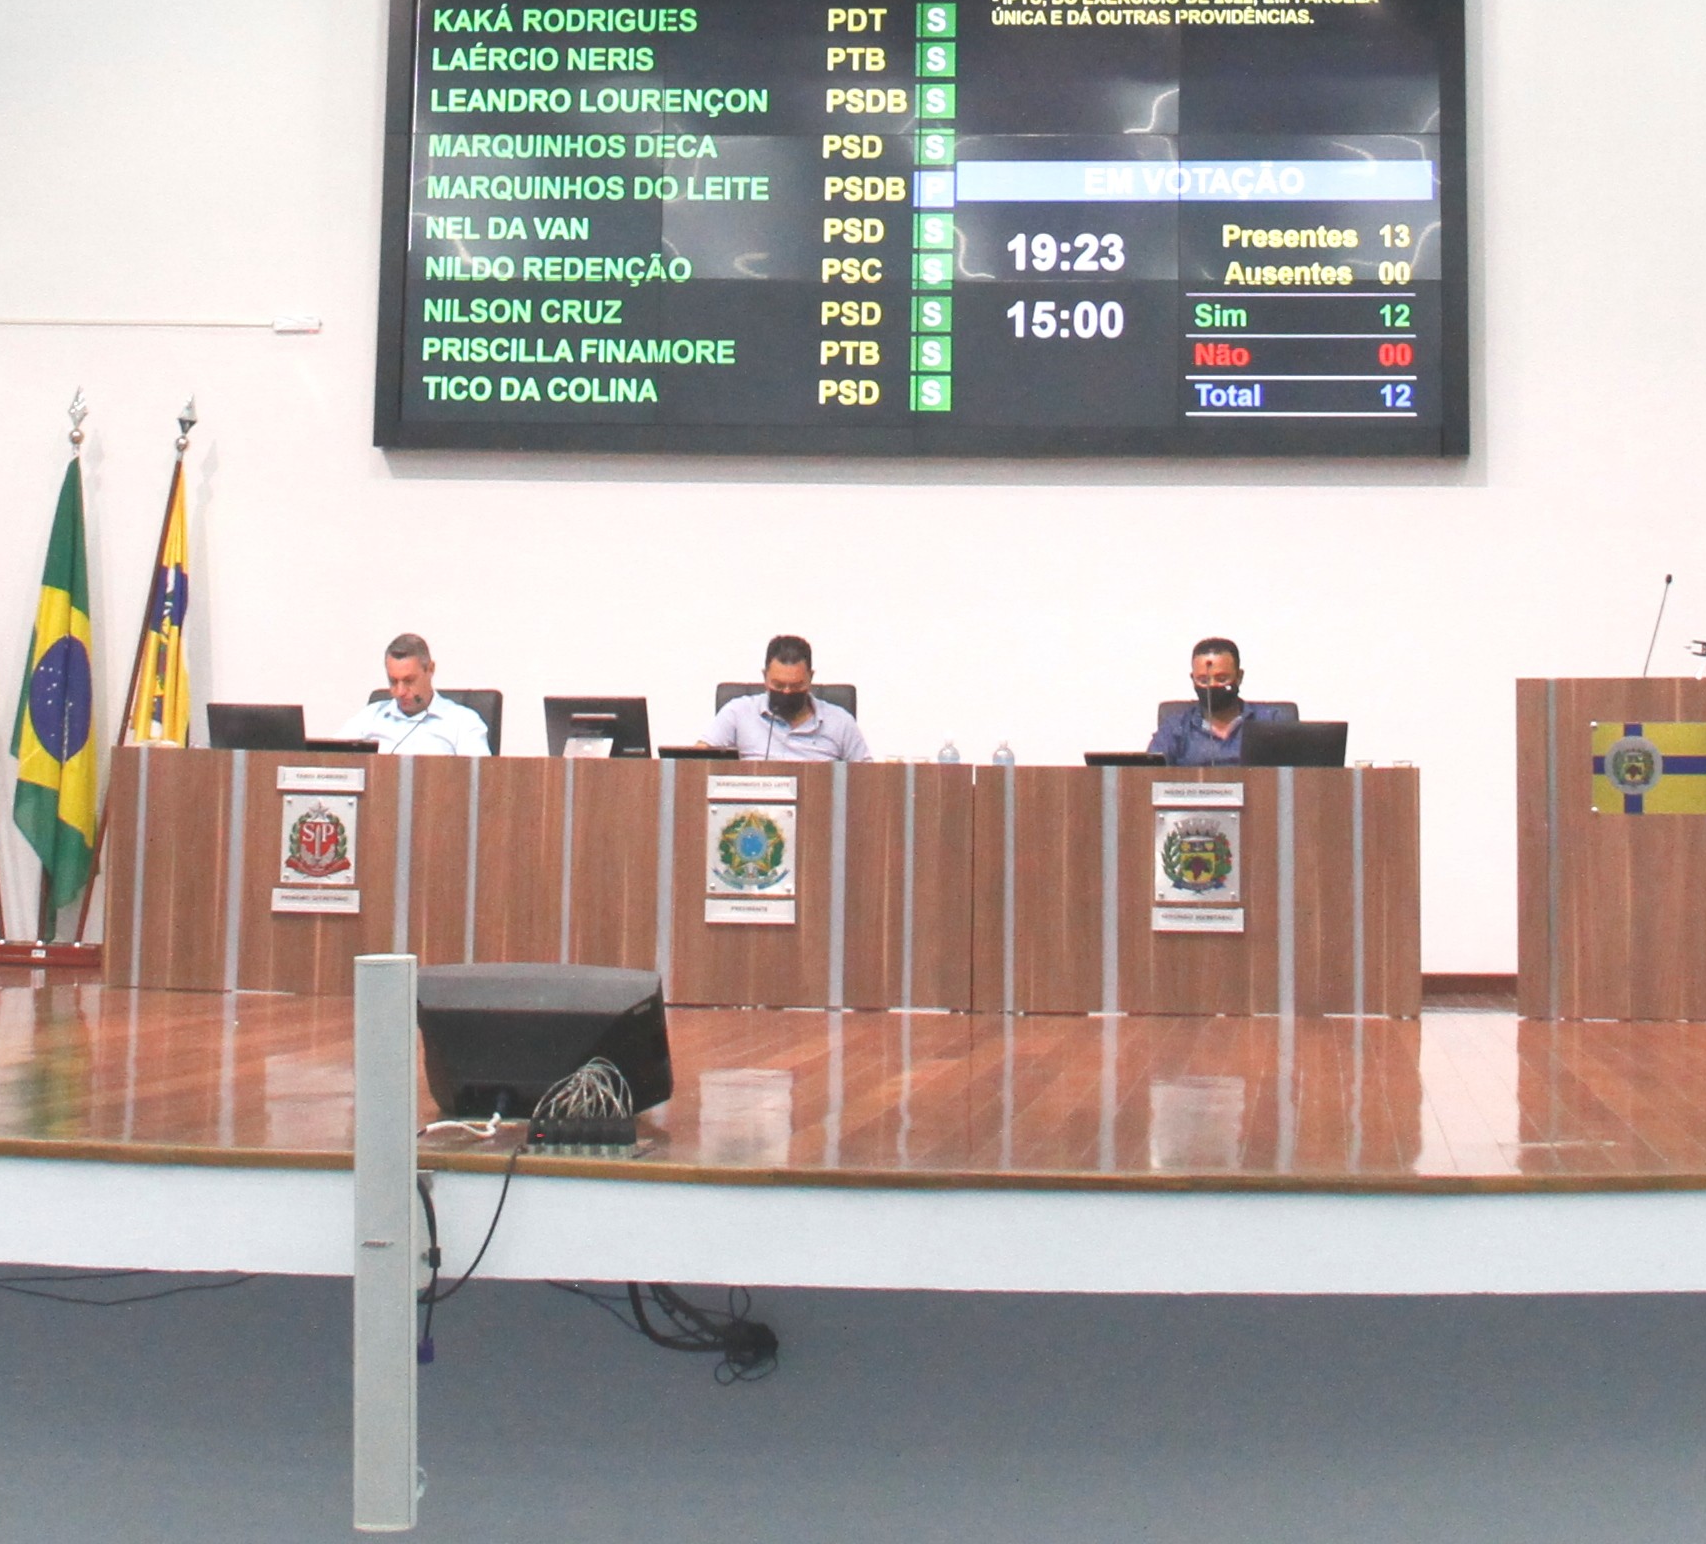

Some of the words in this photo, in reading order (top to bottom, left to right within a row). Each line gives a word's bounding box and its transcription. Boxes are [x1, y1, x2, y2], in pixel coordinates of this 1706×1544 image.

[434, 4, 512, 32] KAKÁ
[523, 8, 697, 32] RODRIGUES
[828, 8, 887, 31] PDT
[928, 9, 946, 30] S
[992, 5, 1047, 26] ÚNICA
[1051, 9, 1062, 25] E
[1067, 4, 1092, 25] DÁ
[1096, 9, 1171, 25] OUTRAS
[1175, 4, 1314, 25] PROVIDÊNCIAS.
[433, 44, 559, 71] LAÉRCIO
[567, 48, 654, 71] NERIS
[827, 48, 886, 71] PTB
[927, 49, 946, 70] S
[431, 89, 572, 112] LEANDRO
[580, 89, 768, 118] LOURENÇON
[826, 89, 907, 113] PSDB
[926, 90, 946, 111] S
[429, 134, 626, 161] MARQUINHOS
[634, 134, 717, 160] DECA
[823, 135, 882, 159] PSD
[925, 137, 945, 158] S
[427, 176, 625, 202] MARQUINHOS
[633, 176, 679, 201] DO
[688, 176, 769, 201] LEITE
[824, 177, 906, 202] PSDB
[1086, 169, 1131, 194] EM
[1143, 161, 1305, 199] VOTAÇÃO
[426, 218, 481, 240] NEL
[487, 217, 527, 241] DA
[535, 218, 589, 240] VAN
[823, 219, 884, 243] PSD
[924, 220, 944, 243] S
[1223, 224, 1358, 248] Presentes
[1379, 224, 1410, 247] 13
[1007, 233, 1126, 272] 19:23
[426, 257, 515, 281] NILDO
[523, 253, 692, 287] REDENÇÃO
[822, 258, 882, 283] PSC
[923, 260, 942, 282] S
[1224, 262, 1352, 285] Ausentes
[1379, 262, 1411, 284] 00
[424, 300, 531, 324] NILSON
[541, 300, 622, 324] CRUZ
[821, 301, 882, 326] PSD
[922, 303, 942, 324] S
[1007, 301, 1124, 338] 15:00
[1194, 305, 1246, 327] Sim
[1380, 304, 1411, 327] 12
[423, 338, 573, 363] PRISCILLA
[580, 339, 735, 364] FINAMORE
[821, 341, 880, 365] PTB
[921, 343, 941, 365] S
[1194, 343, 1250, 366] Não
[1378, 343, 1412, 366] 00
[424, 376, 492, 401] TICO
[501, 376, 541, 402] DA
[548, 377, 658, 402] COLINA
[819, 380, 880, 405] PSD
[921, 382, 941, 403] S
[1195, 384, 1261, 407] Total
[1381, 385, 1411, 407] 12
